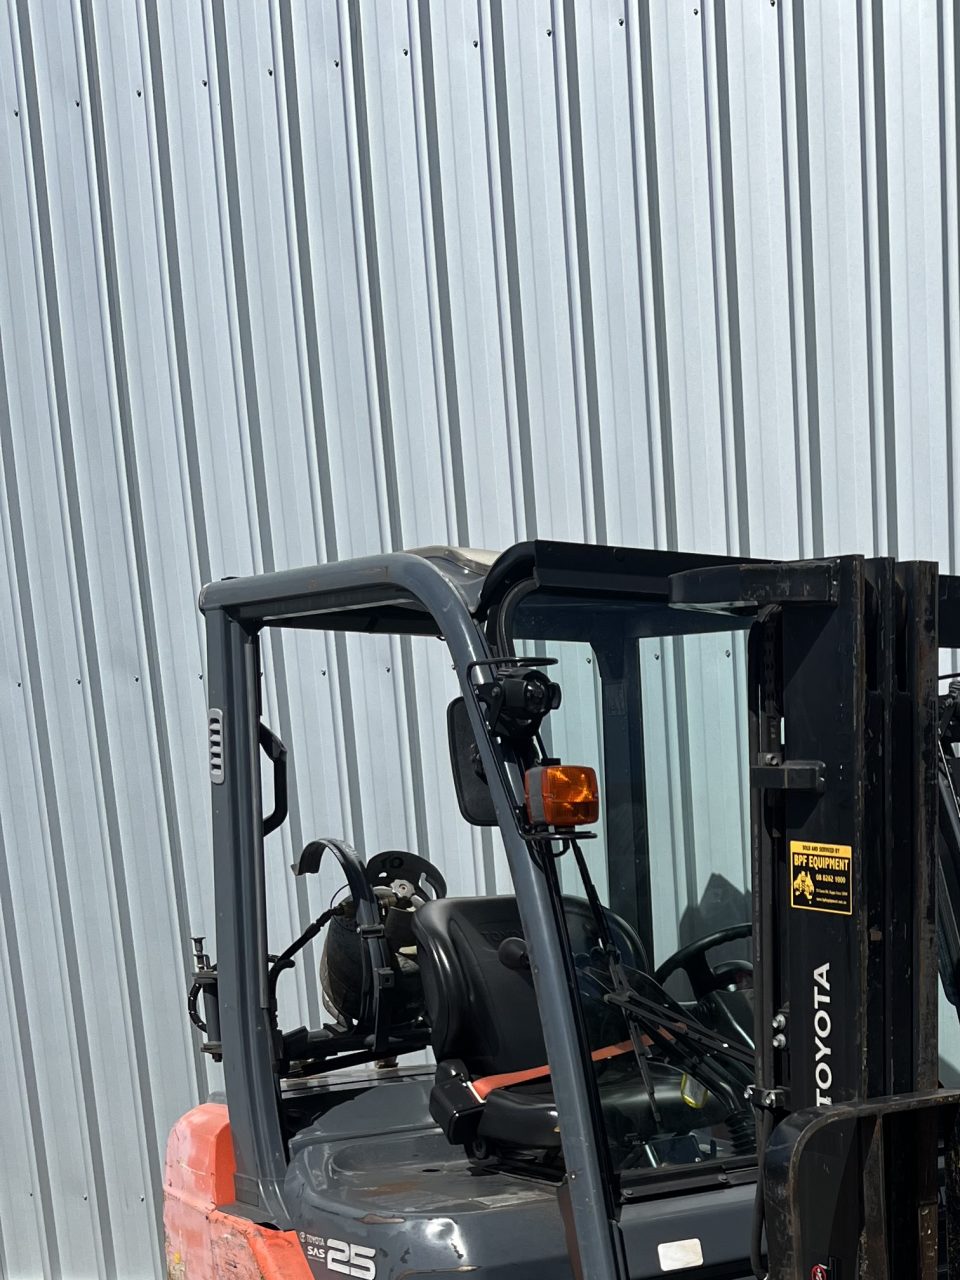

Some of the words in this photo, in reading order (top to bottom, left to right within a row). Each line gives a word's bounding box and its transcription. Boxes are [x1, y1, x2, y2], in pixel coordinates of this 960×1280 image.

[794, 854, 807, 866] BPF
[809, 856, 849, 871] EQUIPMENT
[814, 962, 832, 1107] TOYOTA
[306, 1234, 325, 1246] TOYOTA
[307, 1246, 325, 1258] SAS
[327, 1238, 376, 1280] 25
